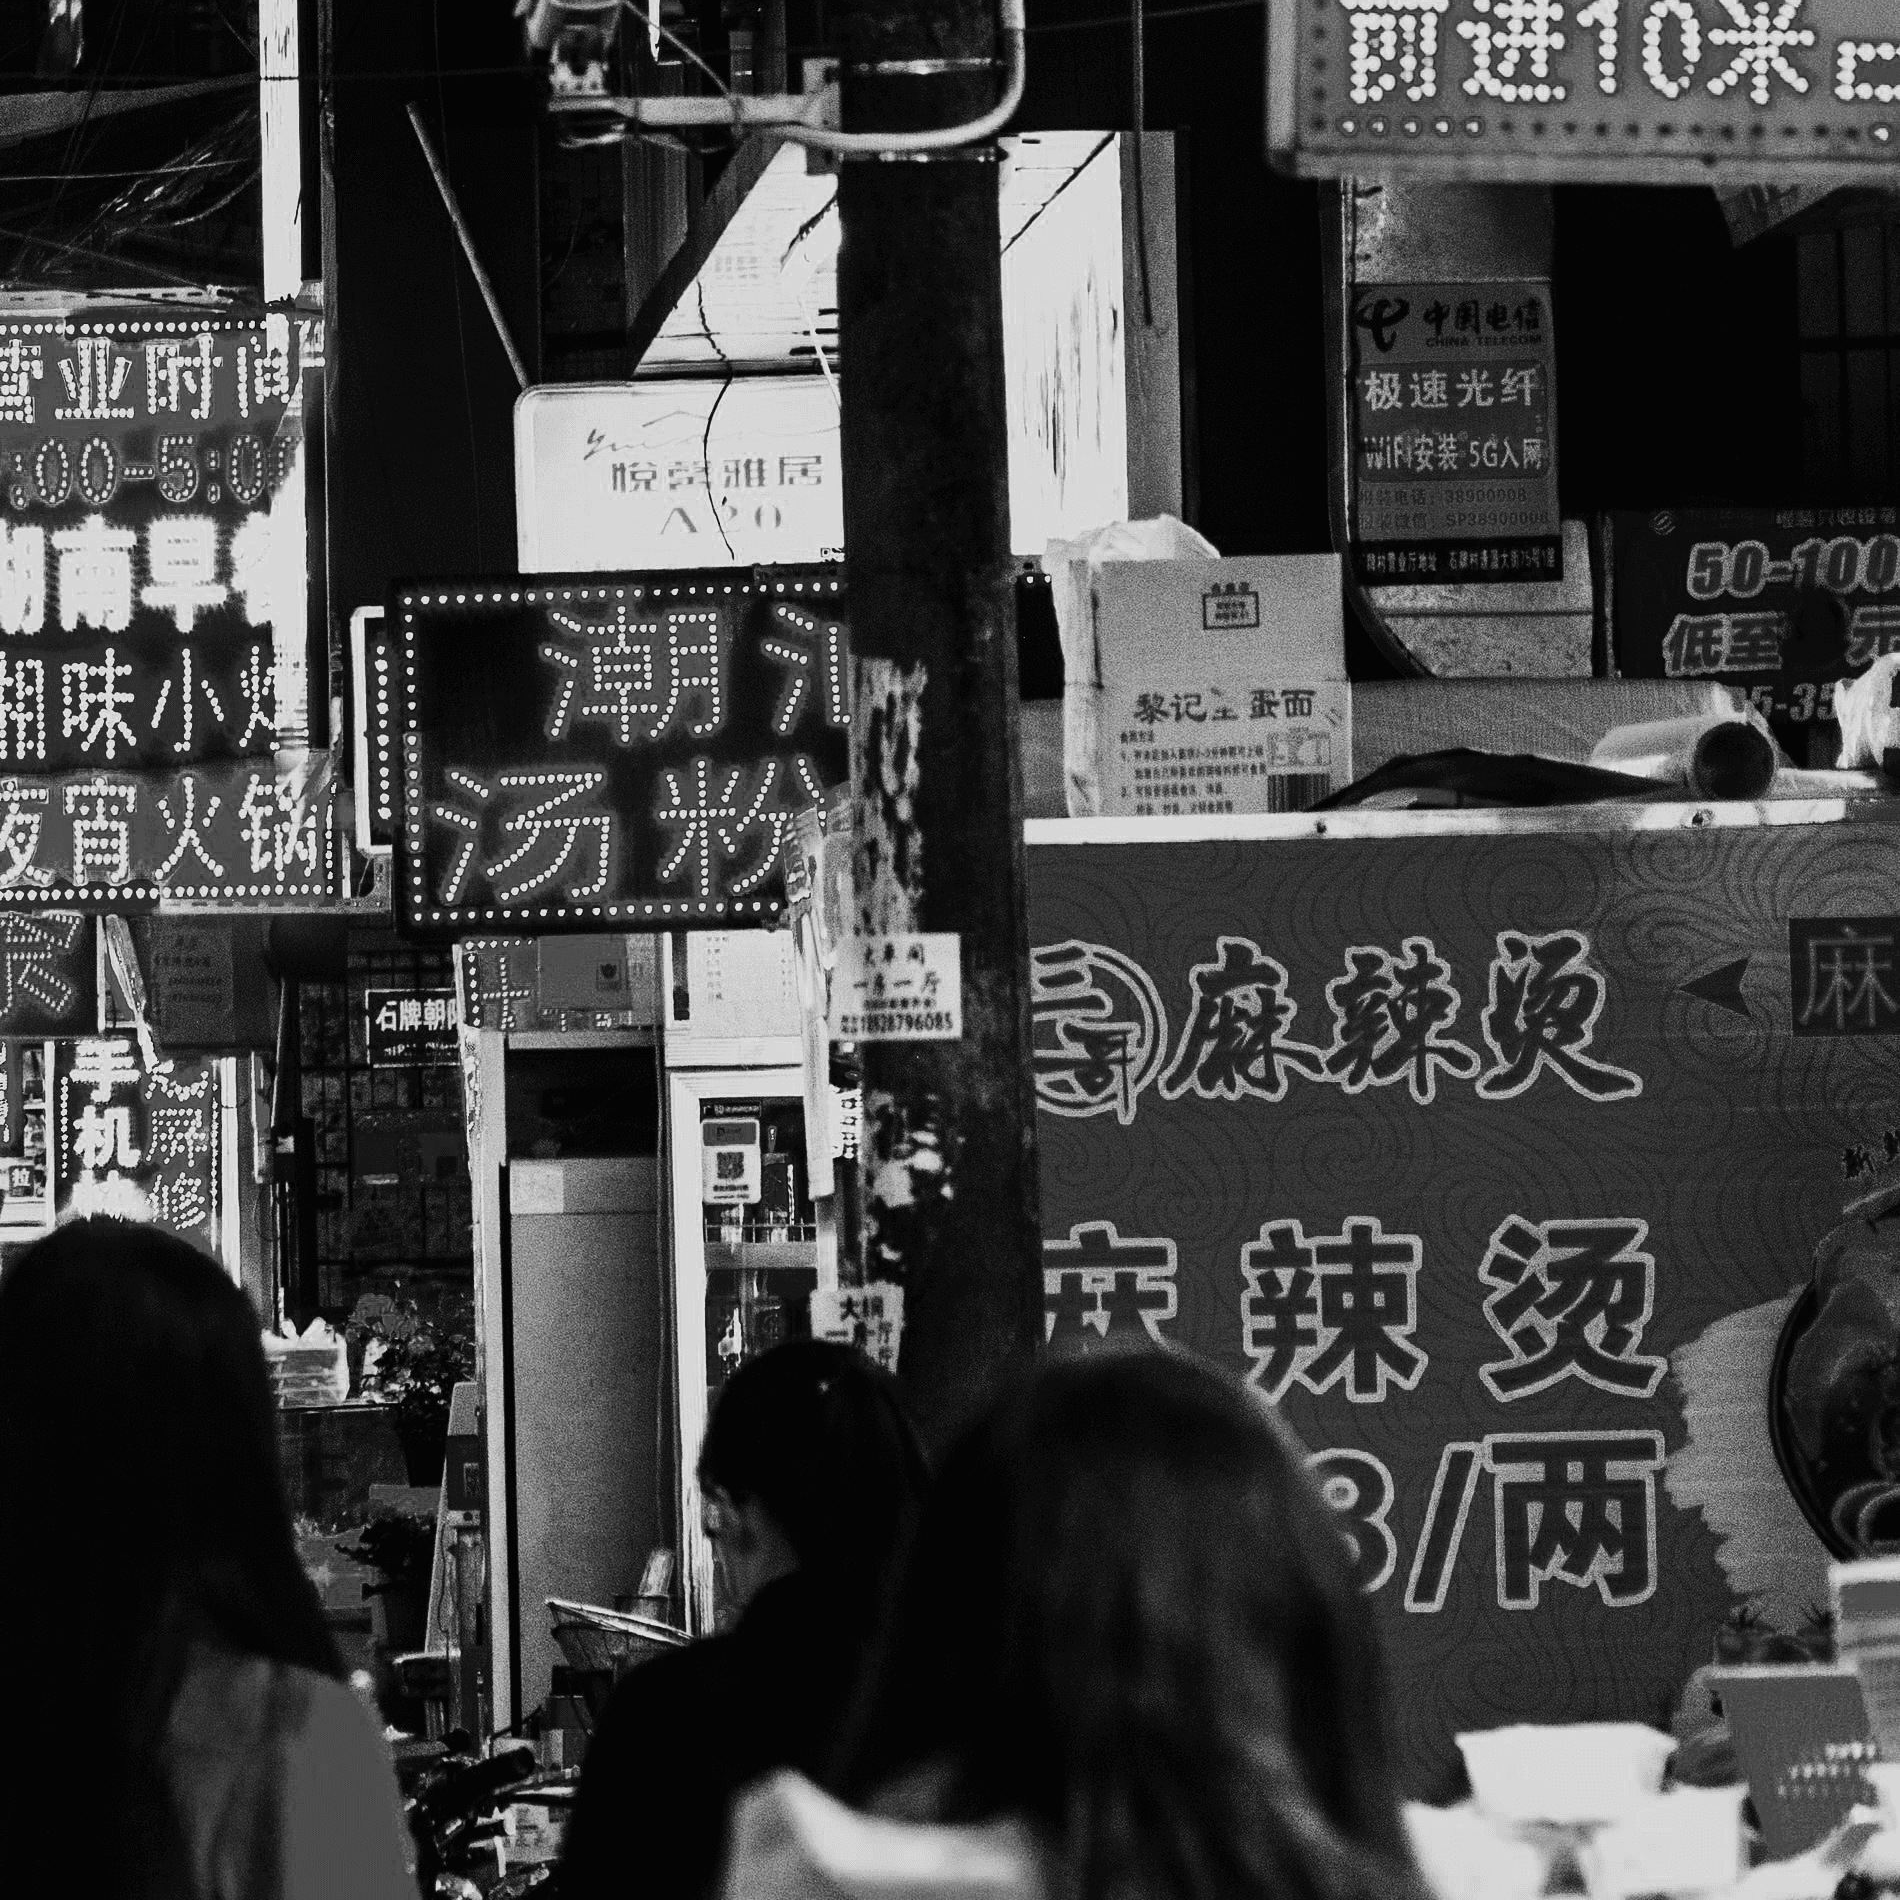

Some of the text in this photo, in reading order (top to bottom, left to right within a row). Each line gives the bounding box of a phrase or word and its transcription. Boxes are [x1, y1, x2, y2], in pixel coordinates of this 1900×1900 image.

[1423, 296, 1541, 336] 中国电信
[1425, 334, 1542, 348] CHINA TELECOM
[1364, 367, 1538, 411] 极速光纤
[434, 756, 830, 907] 汤粉
[1159, 932, 1642, 1104] 麻辣烫
